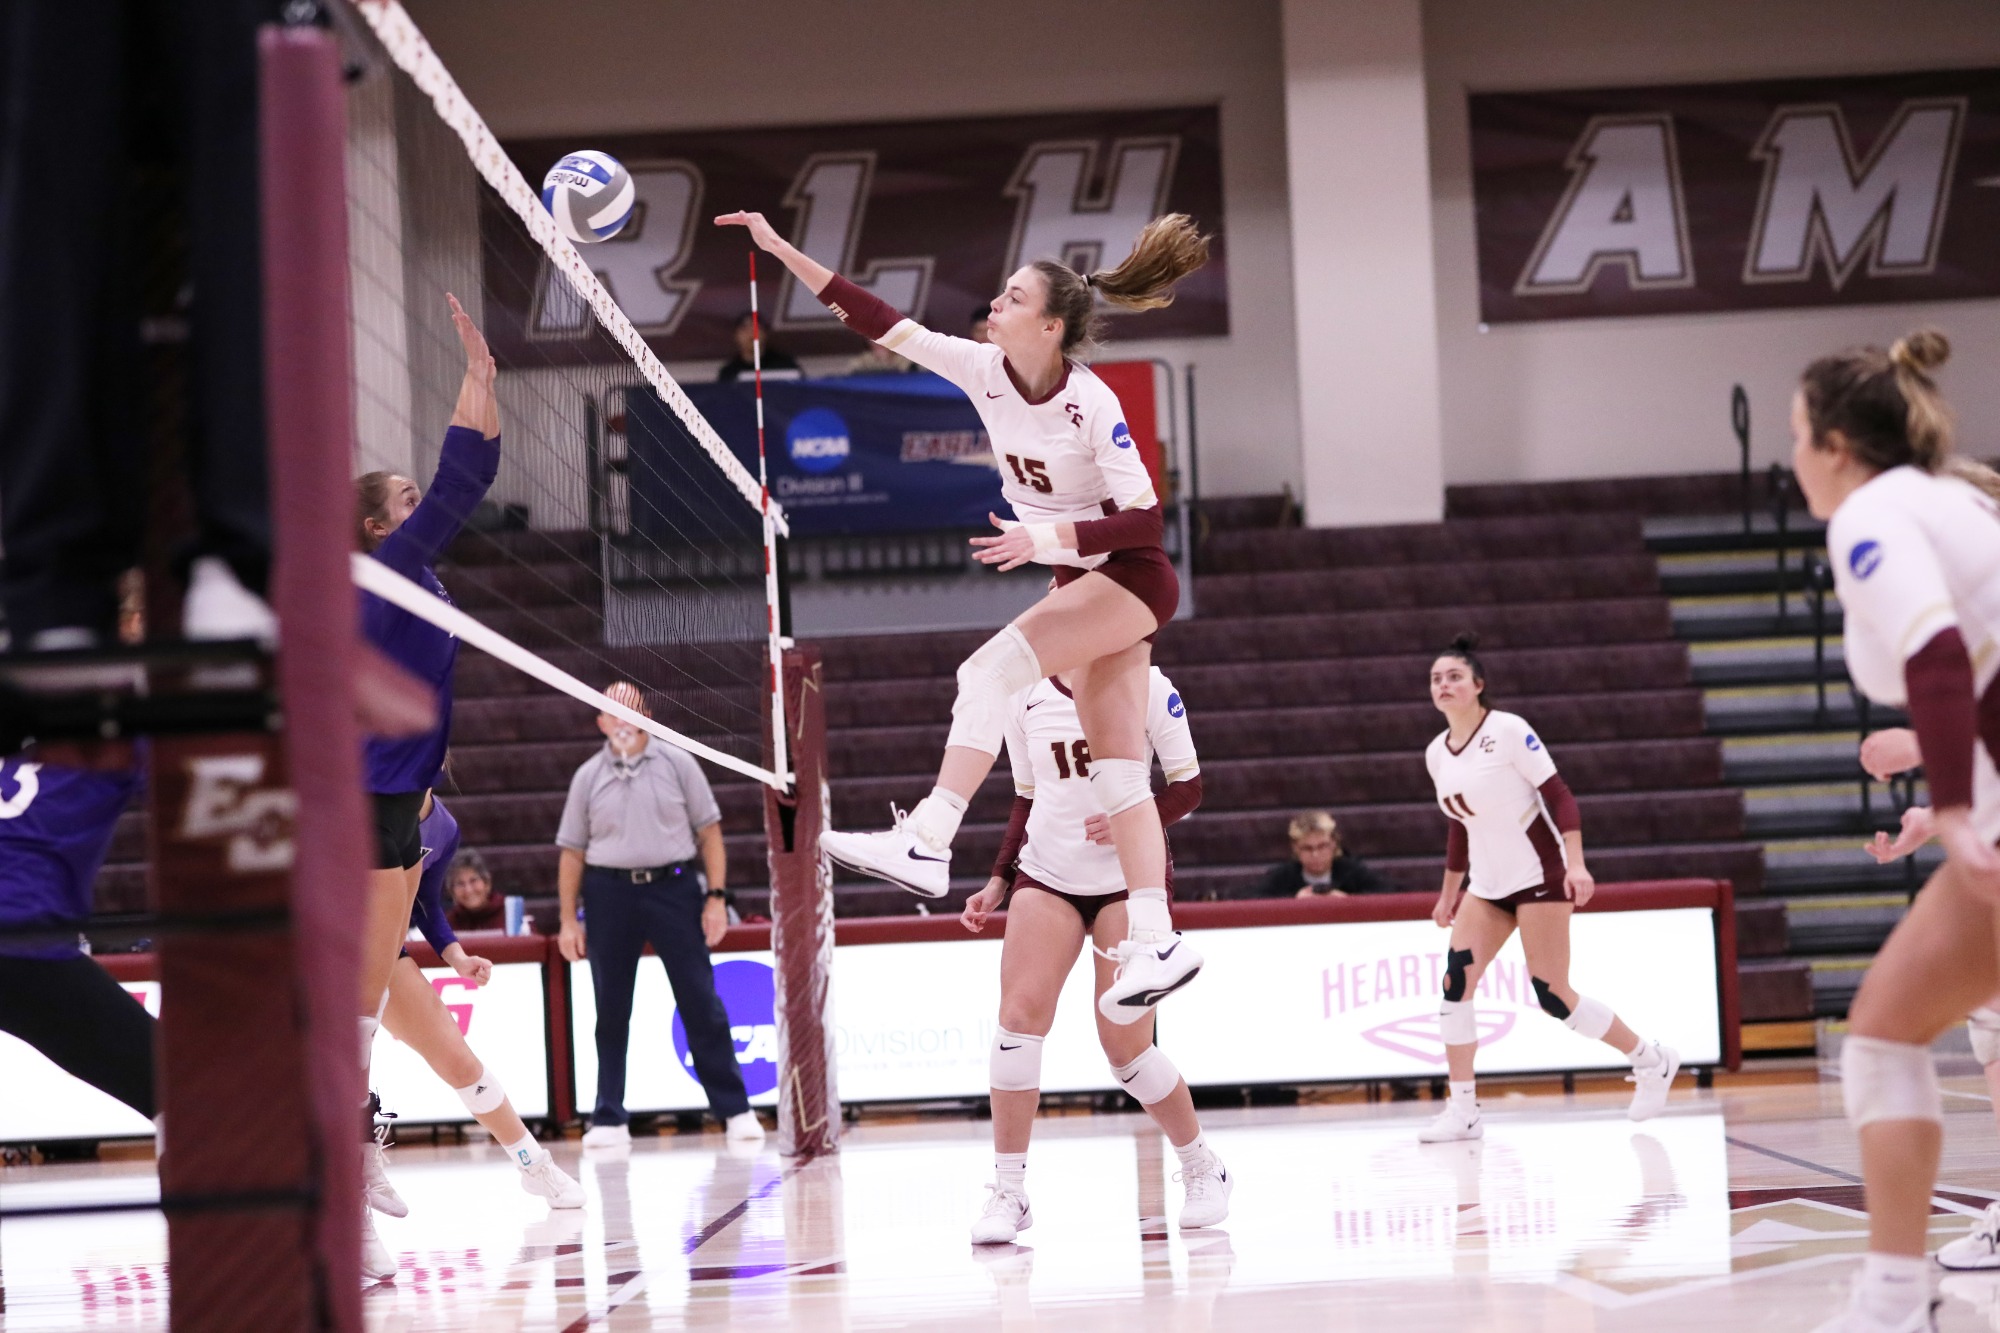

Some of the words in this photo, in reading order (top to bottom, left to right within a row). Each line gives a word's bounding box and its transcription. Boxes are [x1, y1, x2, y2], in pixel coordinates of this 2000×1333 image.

[1005, 453, 1053, 494] 15
[1050, 739, 1093, 780] 18
[1443, 793, 1476, 819] 11
[1322, 953, 1541, 1020] HEARTAN
